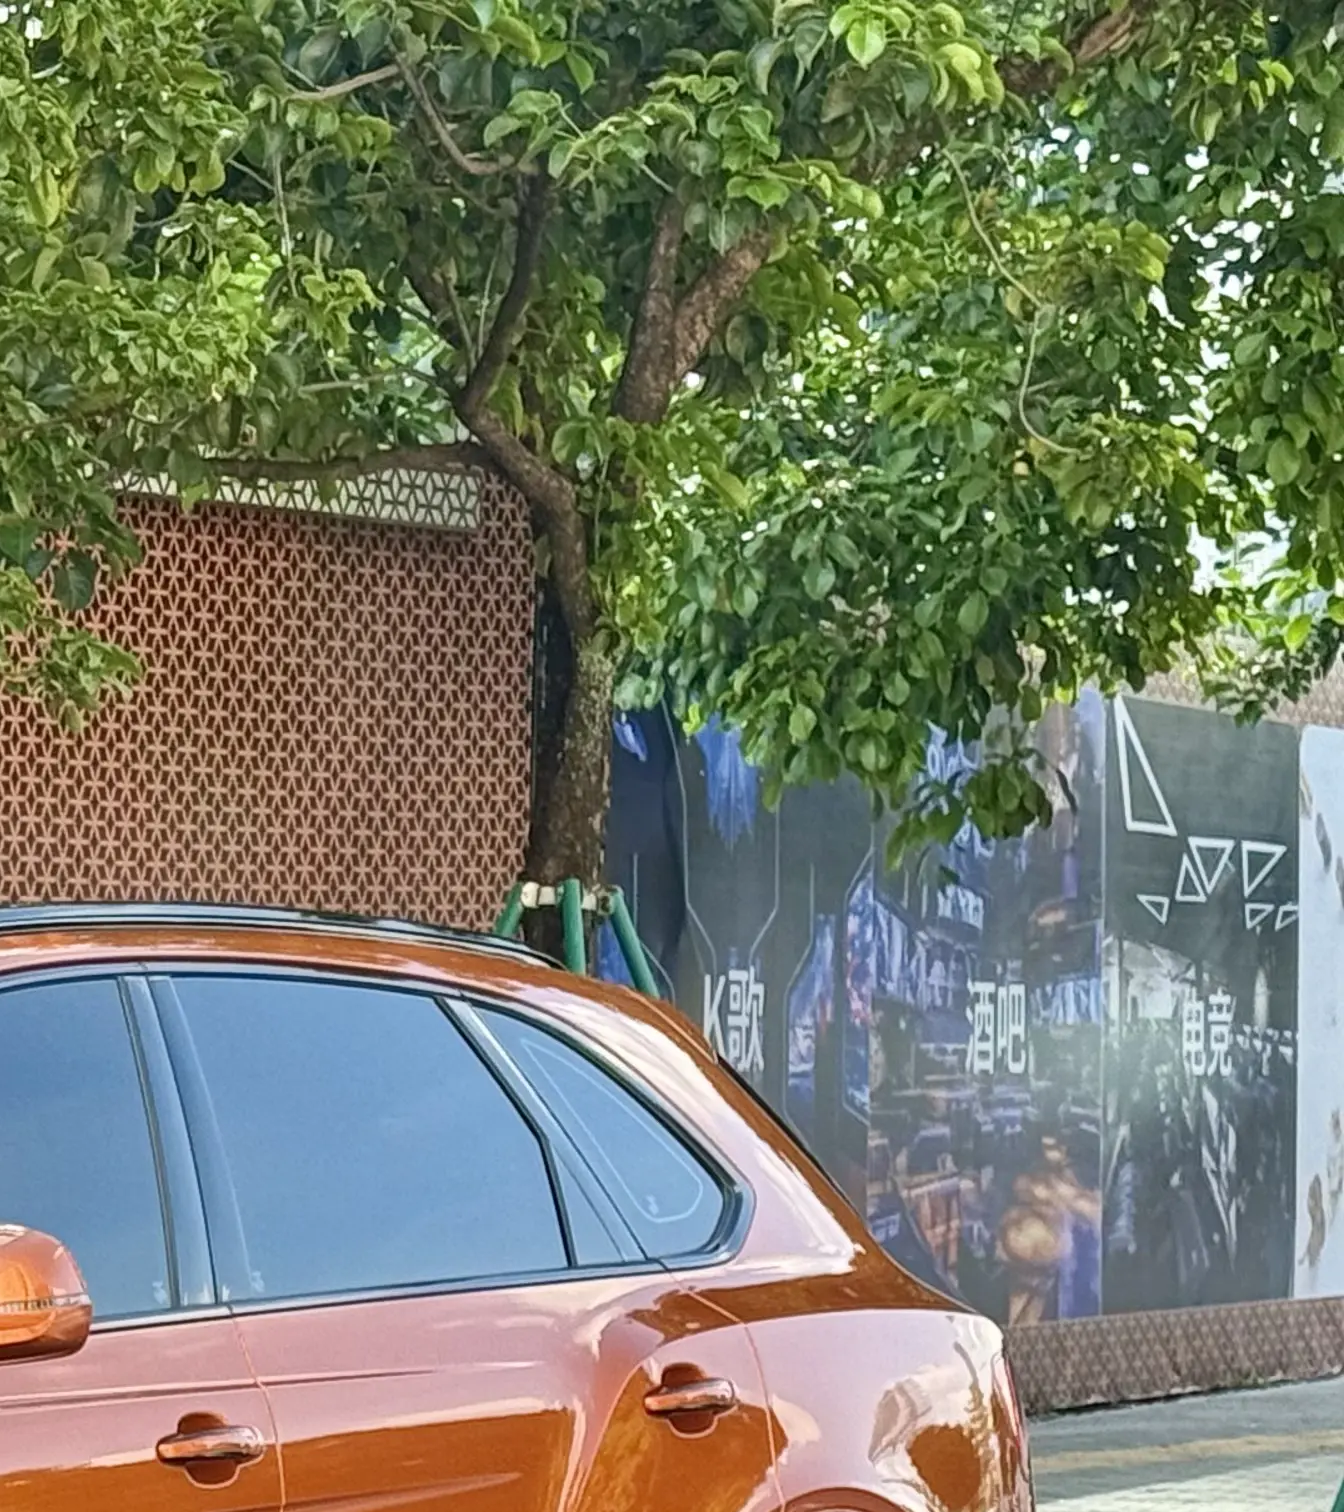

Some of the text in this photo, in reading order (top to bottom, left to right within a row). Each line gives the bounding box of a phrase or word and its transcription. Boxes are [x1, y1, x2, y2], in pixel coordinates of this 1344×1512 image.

[703, 965, 764, 1073] K歌
[965, 978, 1026, 1075] 酒吧
[1183, 985, 1232, 1077] 电竞
